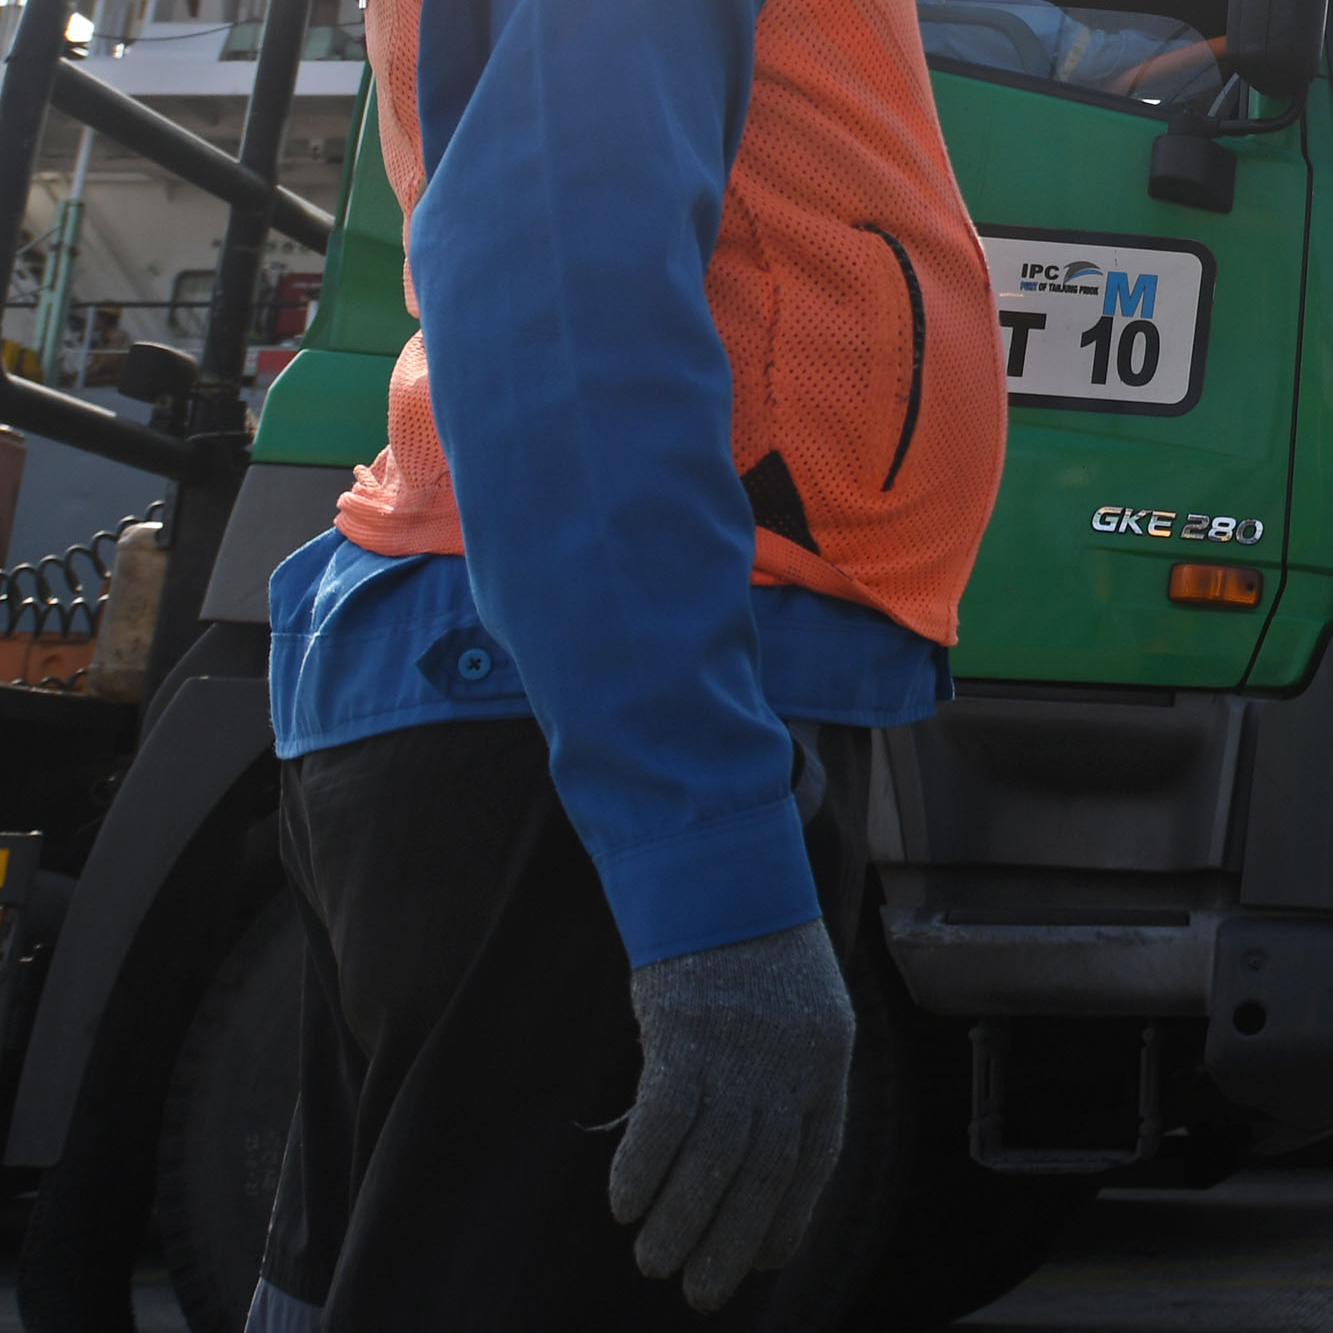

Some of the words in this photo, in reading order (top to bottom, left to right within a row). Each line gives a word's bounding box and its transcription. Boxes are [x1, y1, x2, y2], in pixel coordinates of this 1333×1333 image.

[1021, 263, 1060, 280] IPC
[1038, 282, 1047, 292] OF
[1103, 271, 1159, 319] M
[1080, 316, 1161, 387] 10
[1091, 506, 1177, 538] GKE
[1180, 514, 1264, 545] 280
